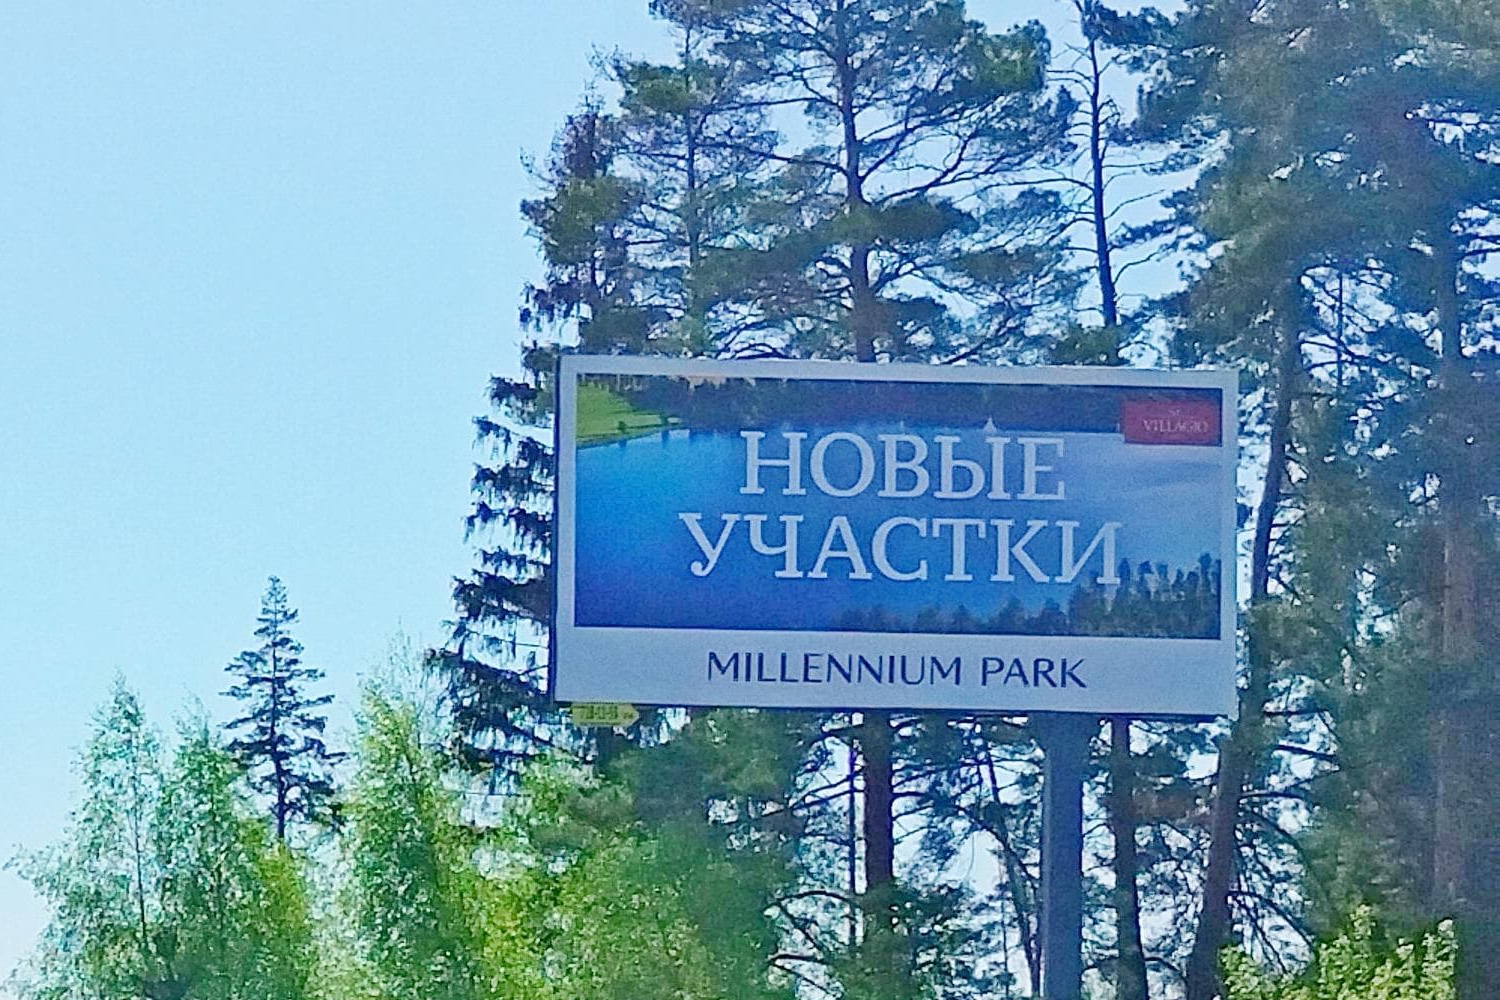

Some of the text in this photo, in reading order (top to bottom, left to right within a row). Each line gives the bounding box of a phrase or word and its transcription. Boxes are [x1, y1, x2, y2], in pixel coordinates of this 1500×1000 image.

[738, 429, 1066, 501] НОВЫЕ
[678, 512, 1122, 585] УЧАСТКИ
[706, 651, 1088, 688] MILLENNIUM PARK
